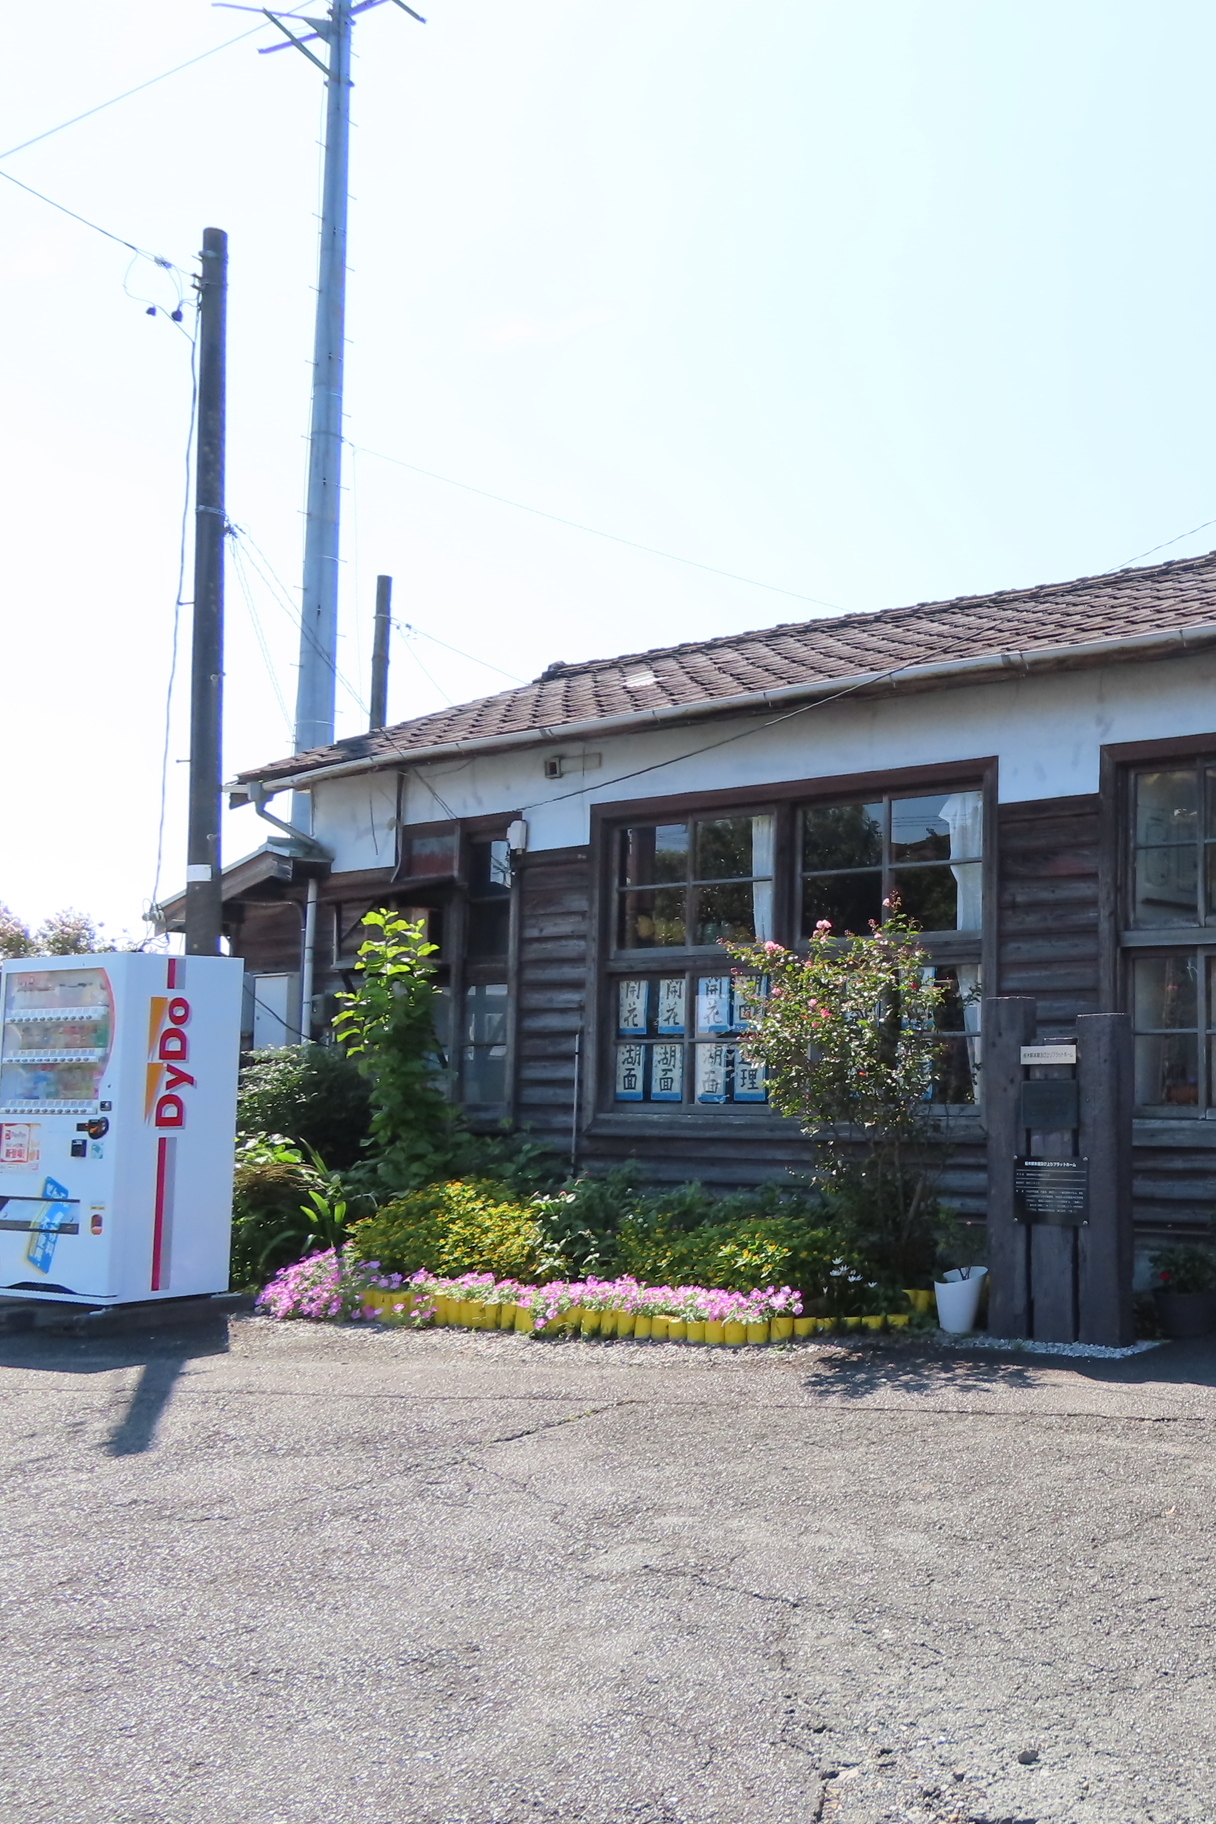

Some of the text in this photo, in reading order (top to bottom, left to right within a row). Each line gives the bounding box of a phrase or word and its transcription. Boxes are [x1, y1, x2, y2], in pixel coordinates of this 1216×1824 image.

[154, 997, 195, 1128] DyDo
[621, 1044, 641, 1091] 湖面
[657, 1044, 677, 1092] 湖面
[738, 1057, 759, 1090] 理
